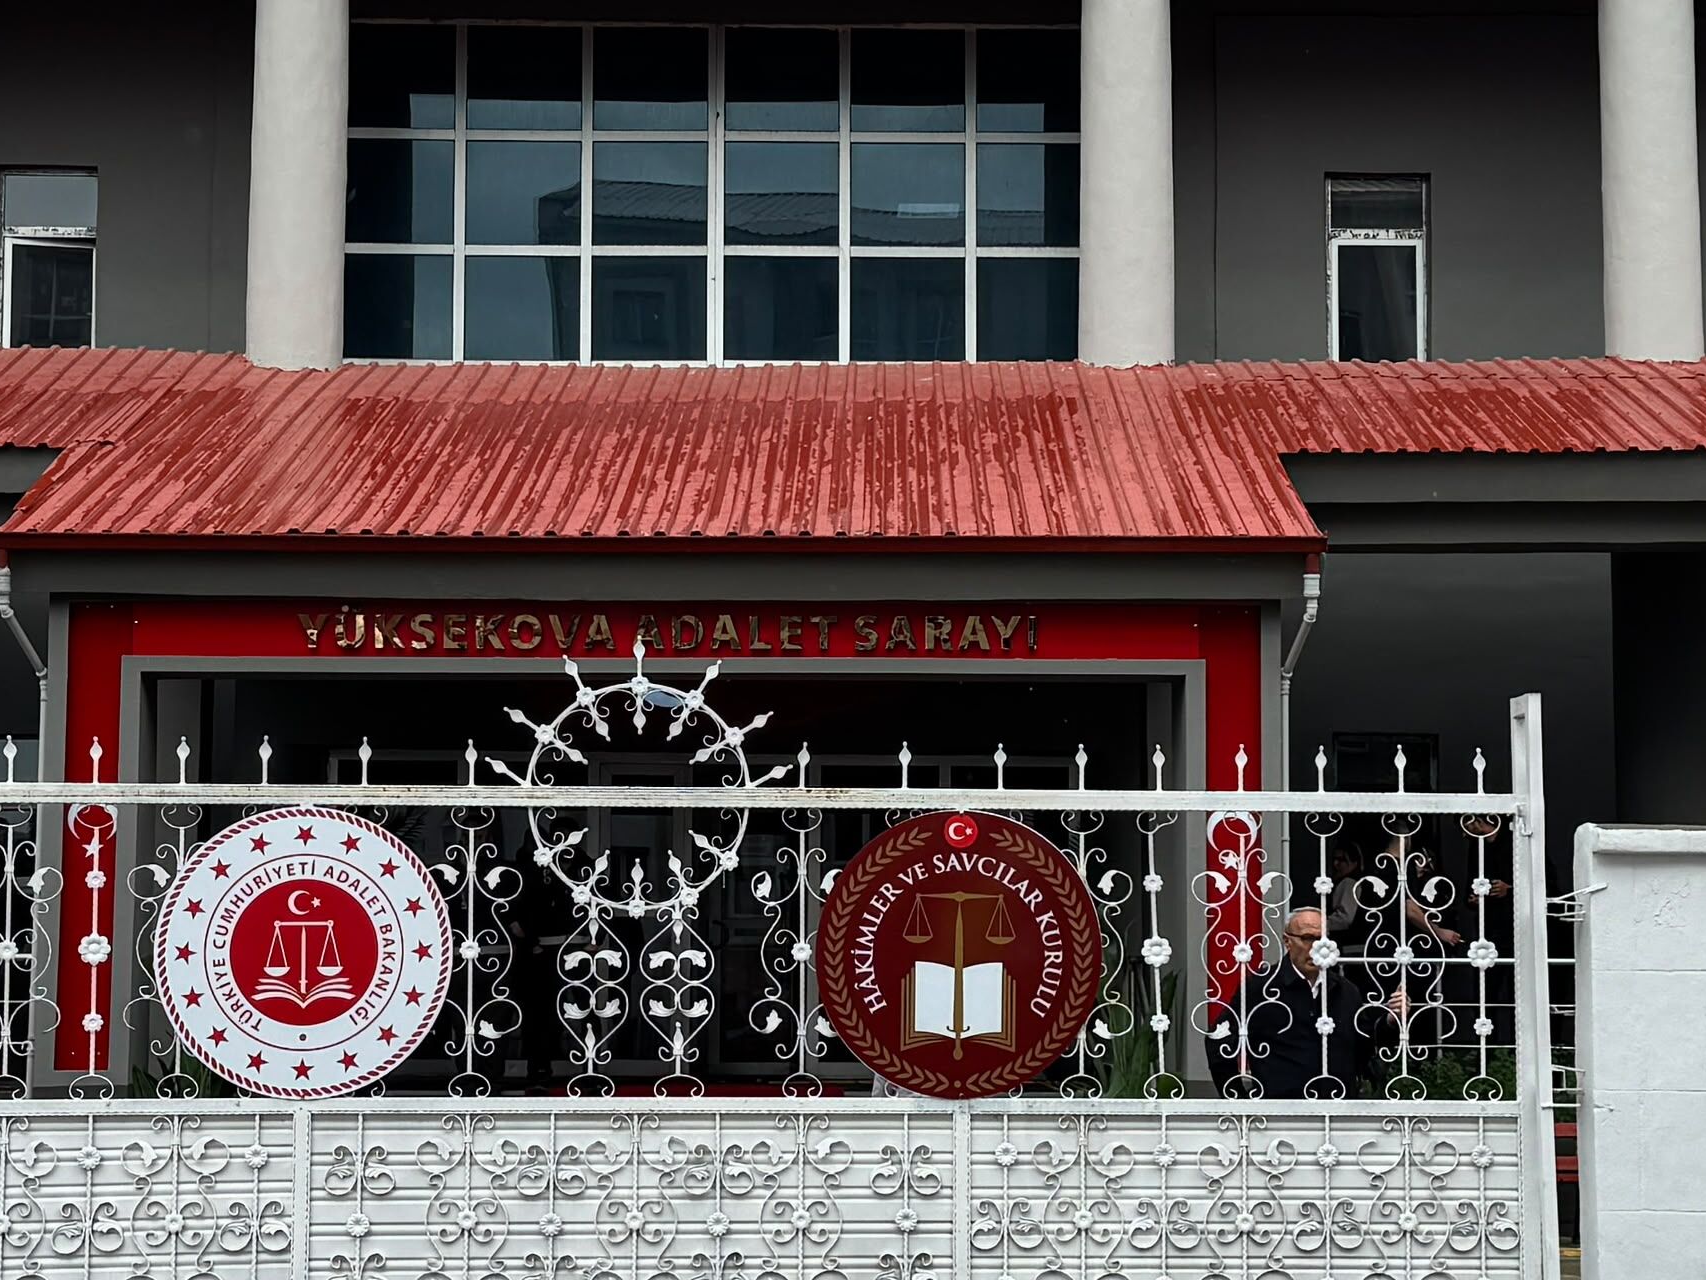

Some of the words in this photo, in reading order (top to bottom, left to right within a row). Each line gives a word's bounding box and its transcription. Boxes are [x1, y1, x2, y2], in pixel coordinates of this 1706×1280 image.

[298, 605, 616, 650] YÜKSEKOVA
[633, 614, 838, 650] ADALET
[855, 614, 1037, 651] SARAYI
[213, 859, 317, 950] CUMHURİYETİ
[323, 864, 387, 918] ADALET
[349, 922, 397, 1027] BAKANLIĞI
[850, 881, 904, 1015] HÂKİMLER
[897, 862, 929, 886] VE
[932, 852, 1044, 913] SAVCILAR
[1030, 910, 1064, 1019] KURULU
[212, 956, 262, 1032] TÜRKİYE
